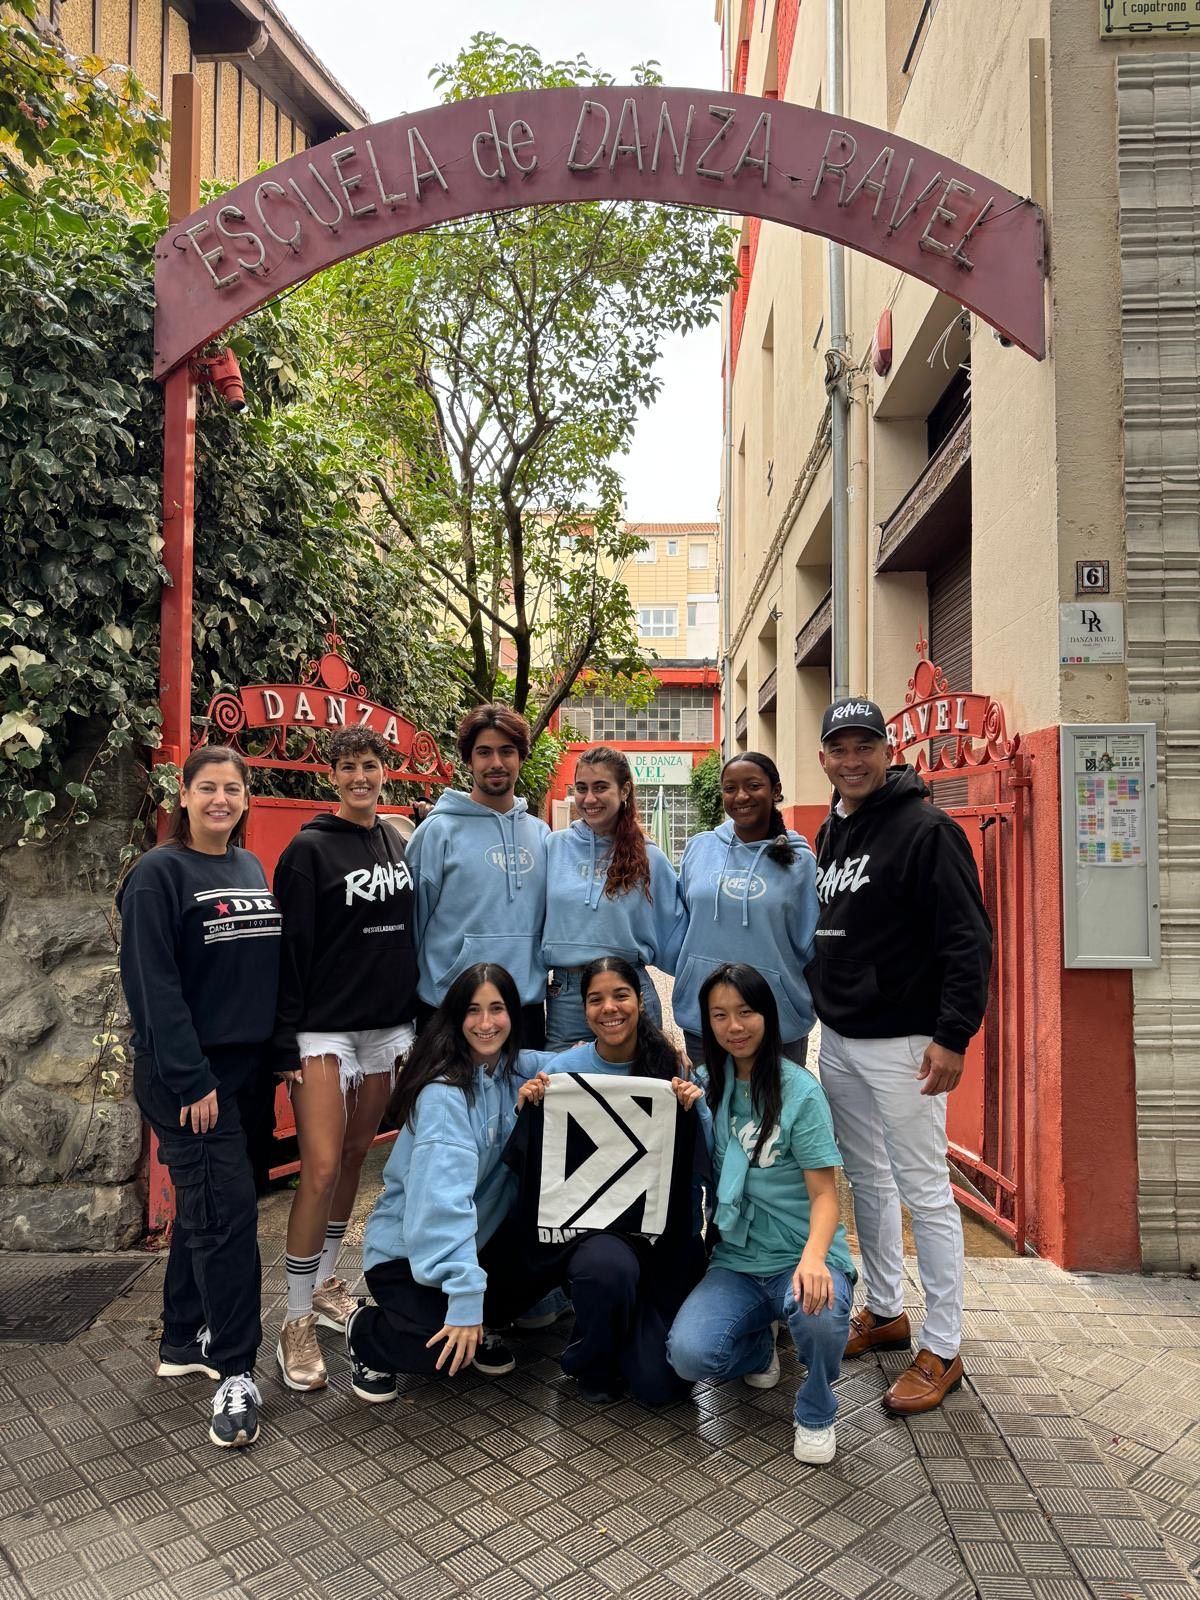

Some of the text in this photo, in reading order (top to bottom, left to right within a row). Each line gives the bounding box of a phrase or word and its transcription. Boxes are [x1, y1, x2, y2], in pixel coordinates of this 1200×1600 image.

[185, 98, 995, 289] ESCUELA de DANZA RAVEL
[1086, 568, 1100, 585] 6
[1080, 609, 1103, 632] DR
[263, 689, 400, 745] DANZA
[831, 702, 873, 722] RAVEL
[886, 698, 969, 747] RAVEL
[636, 756, 647, 766] DE
[651, 756, 683, 766] DANZA
[634, 766, 665, 778] VEL
[343, 860, 414, 906] RAVEL
[231, 898, 276, 912] DR
[208, 922, 235, 934] DANZA
[538, 1227, 588, 1244] DAN
